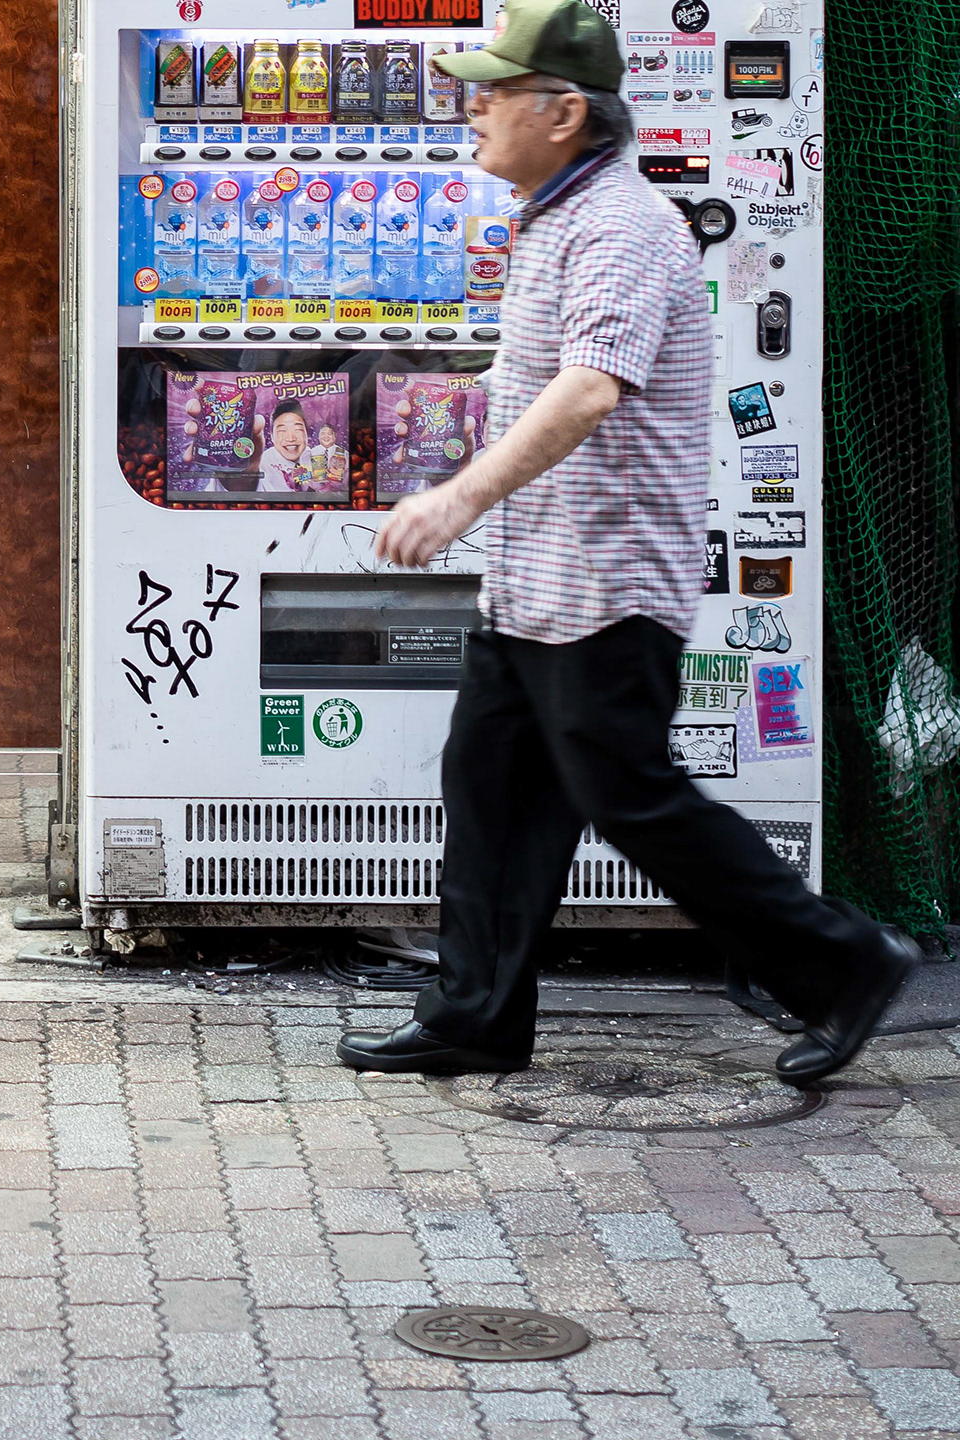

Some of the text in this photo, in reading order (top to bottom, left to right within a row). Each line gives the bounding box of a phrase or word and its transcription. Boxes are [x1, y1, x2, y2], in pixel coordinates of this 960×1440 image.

[736, 159, 770, 175] HOLA
[748, 202, 804, 218] Subjekt.
[747, 215, 797, 229] Objekt.
[160, 307, 192, 317] 100円
[205, 303, 237, 313] 100円
[252, 306, 284, 317] 100円
[295, 303, 327, 313] 100円
[339, 307, 371, 317] 100円
[381, 306, 413, 316] 100円
[427, 307, 459, 317] 100円
[174, 372, 195, 382] New
[384, 374, 405, 383] New
[210, 439, 234, 448] GRAPE
[420, 440, 445, 449] GRAPE
[758, 663, 804, 694] SEX
[265, 697, 299, 707] Green
[264, 706, 300, 715] Power
[673, 729, 727, 737] TRUST
[266, 743, 299, 752] WIND
